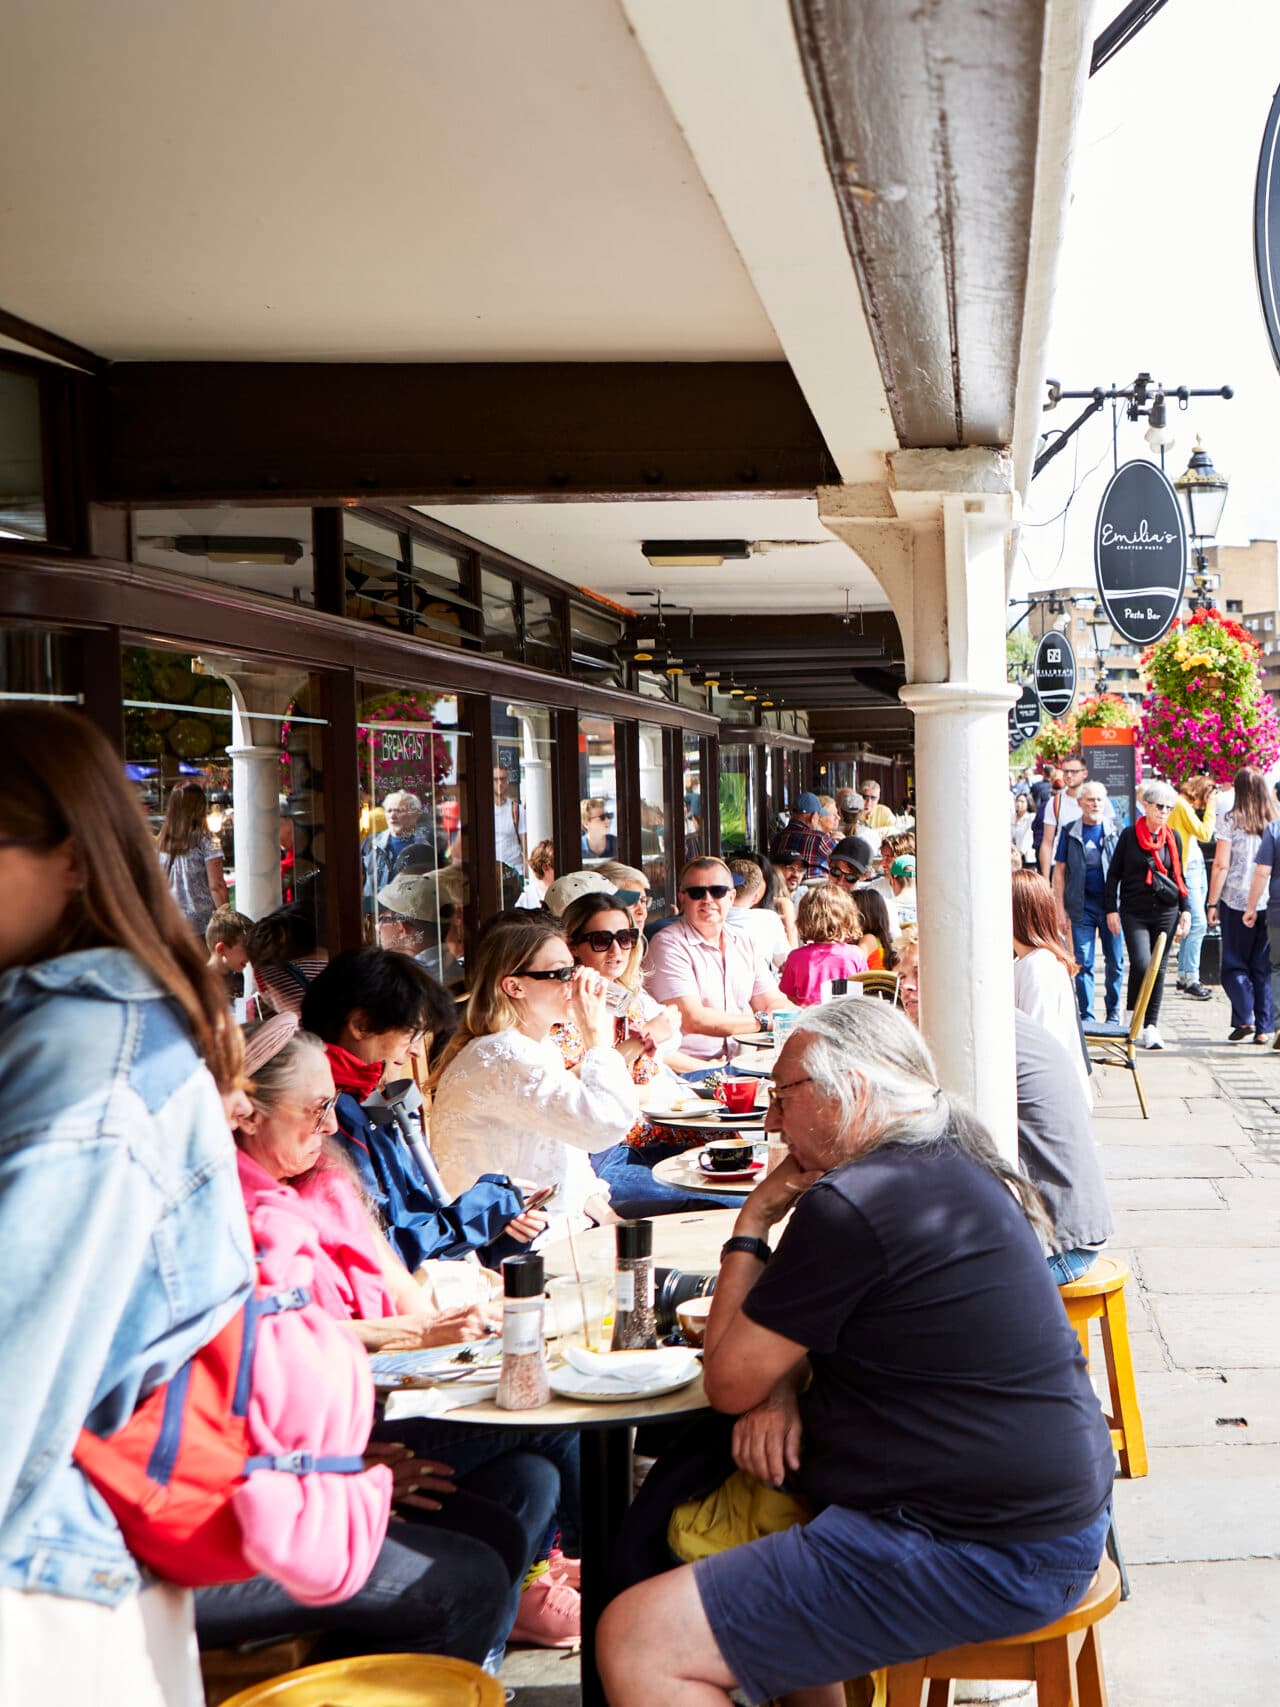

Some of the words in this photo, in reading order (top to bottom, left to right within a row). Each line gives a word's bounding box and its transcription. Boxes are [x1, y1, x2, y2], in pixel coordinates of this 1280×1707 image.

[1102, 519, 1177, 546] Emilia's
[1124, 607, 1145, 620] Pasta
[1146, 607, 1161, 620] Bar
[382, 733, 426, 761] BREAKFAST
